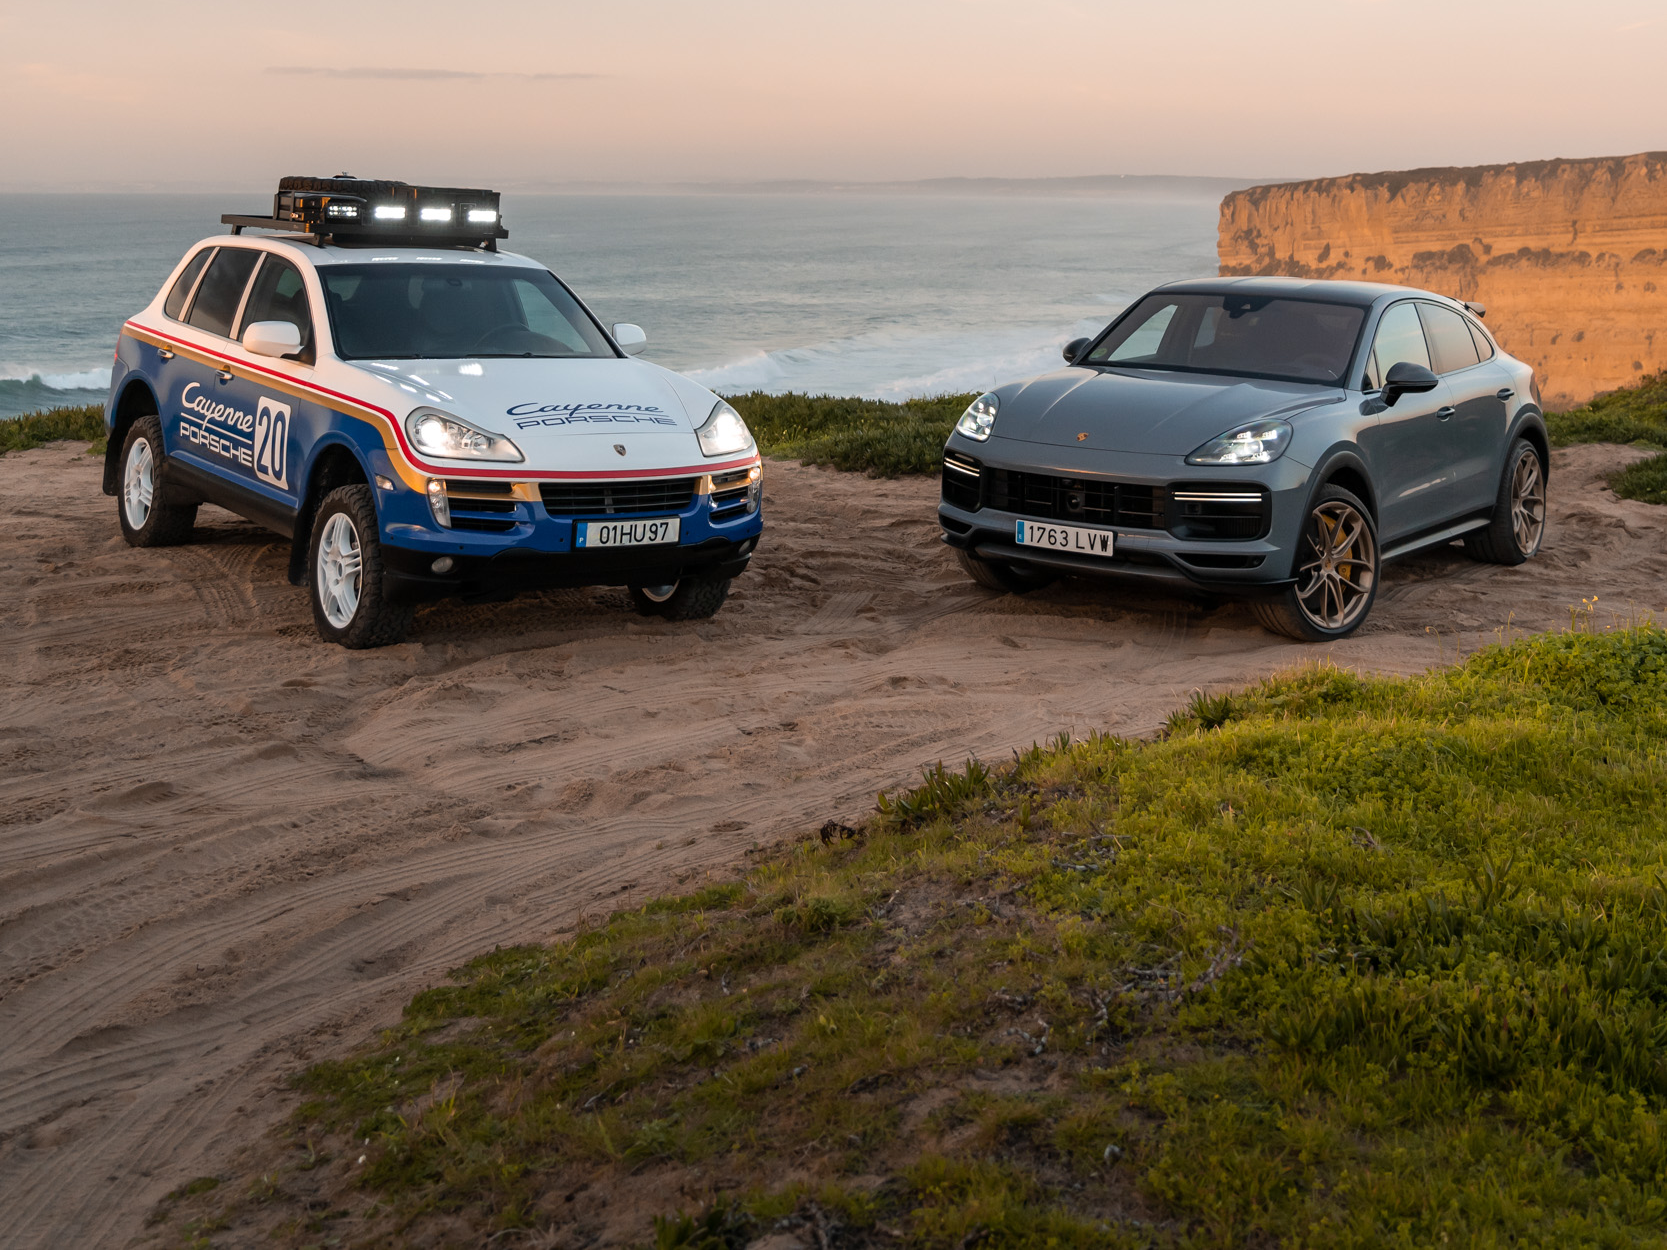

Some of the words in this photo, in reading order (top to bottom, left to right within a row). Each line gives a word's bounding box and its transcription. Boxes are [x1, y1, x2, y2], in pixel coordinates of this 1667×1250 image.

[181, 381, 254, 433] Cayenne
[506, 402, 664, 417] Cayenne
[516, 415, 678, 430] PORSCHE
[180, 421, 253, 468] PORSCHE
[257, 406, 287, 482] 20
[599, 521, 669, 545] 01HU97
[1029, 525, 1069, 547] 1763
[1075, 531, 1109, 553] LVW
